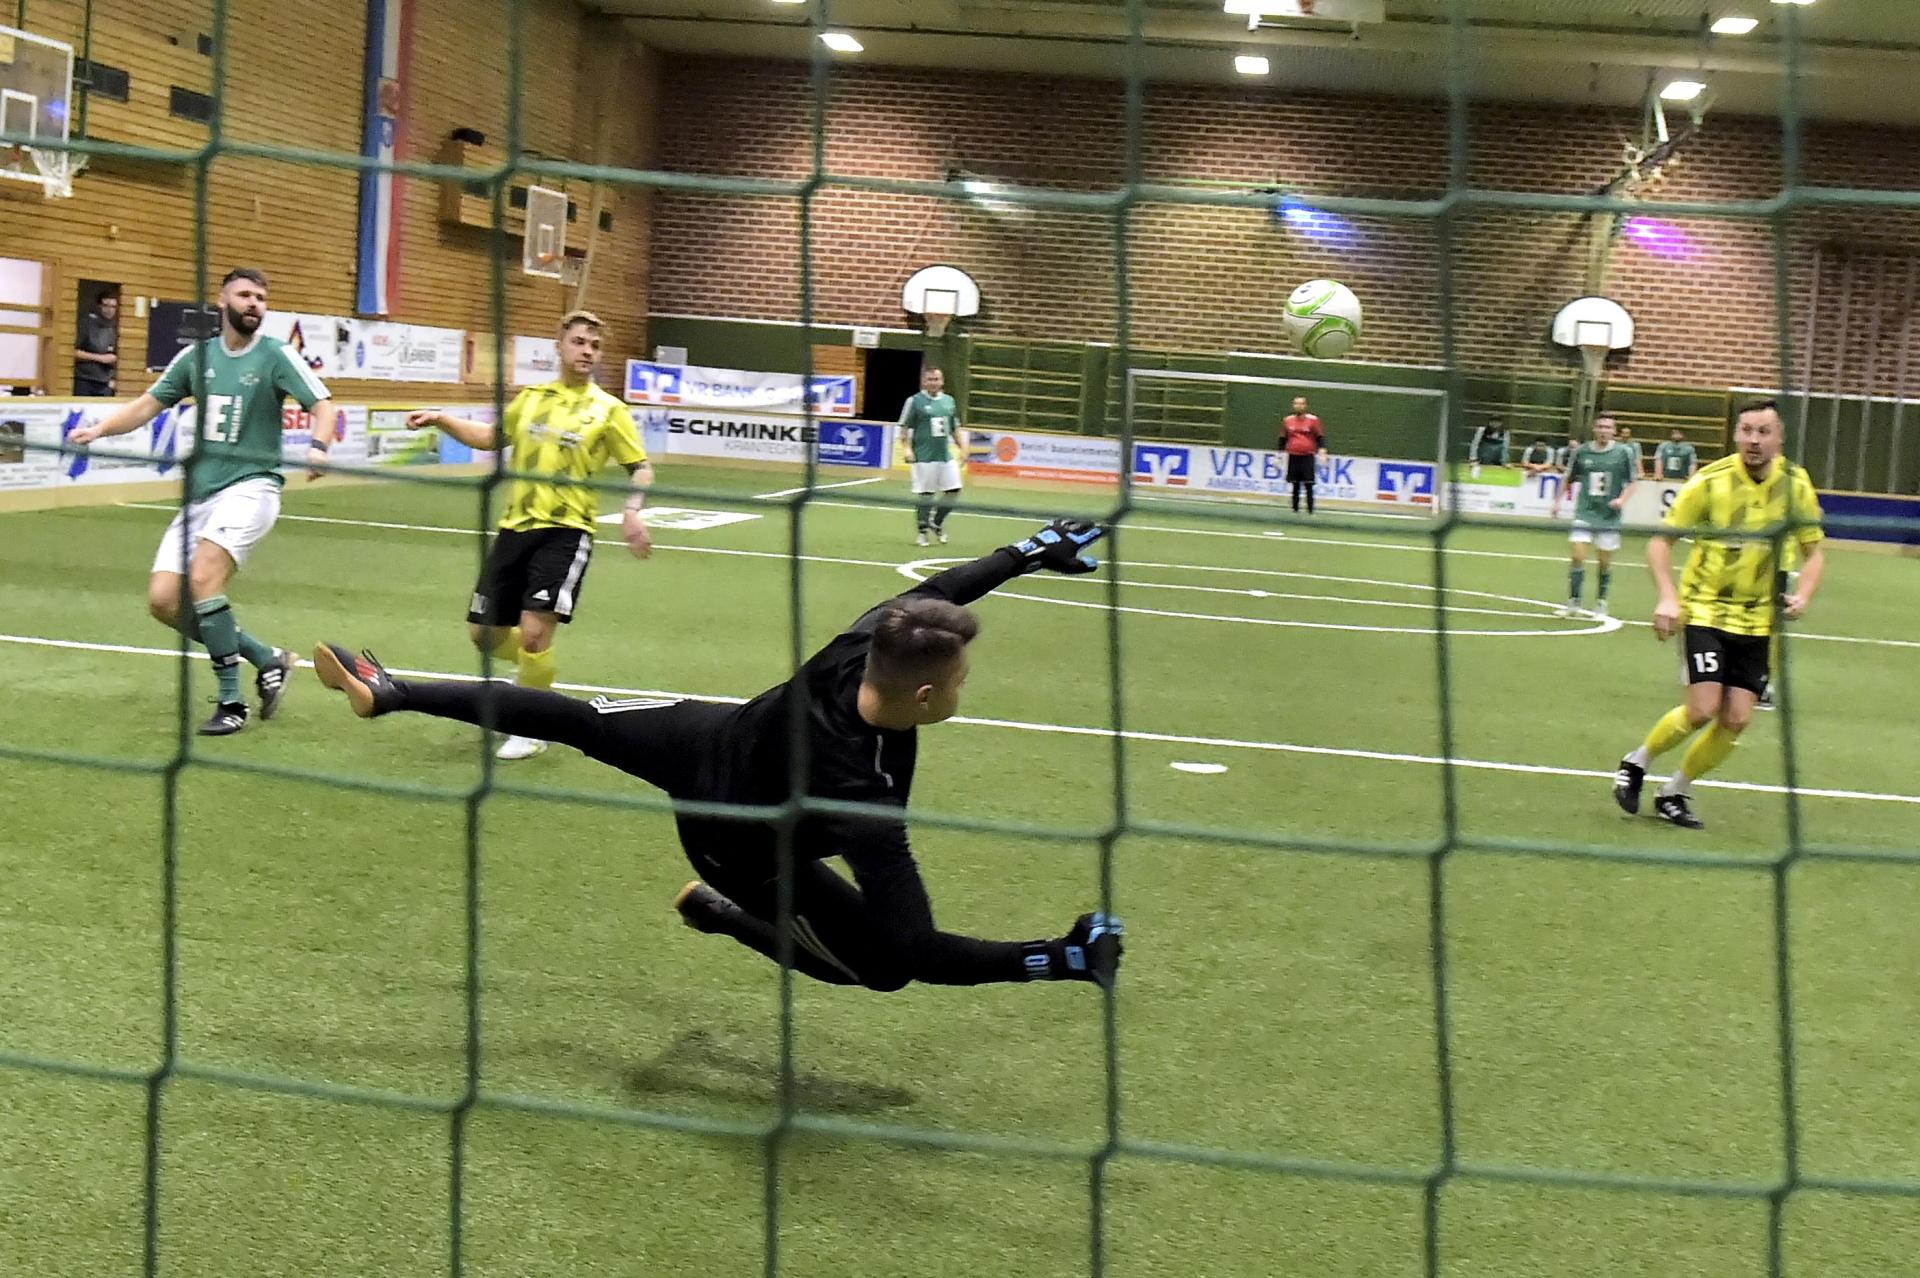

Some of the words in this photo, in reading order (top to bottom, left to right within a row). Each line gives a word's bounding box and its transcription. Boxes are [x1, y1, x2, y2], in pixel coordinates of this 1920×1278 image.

[667, 418, 818, 443] SCHMINKE
[1209, 449, 1252, 478] VR
[1263, 453, 1353, 485] BNK
[1693, 651, 1719, 673] 15
